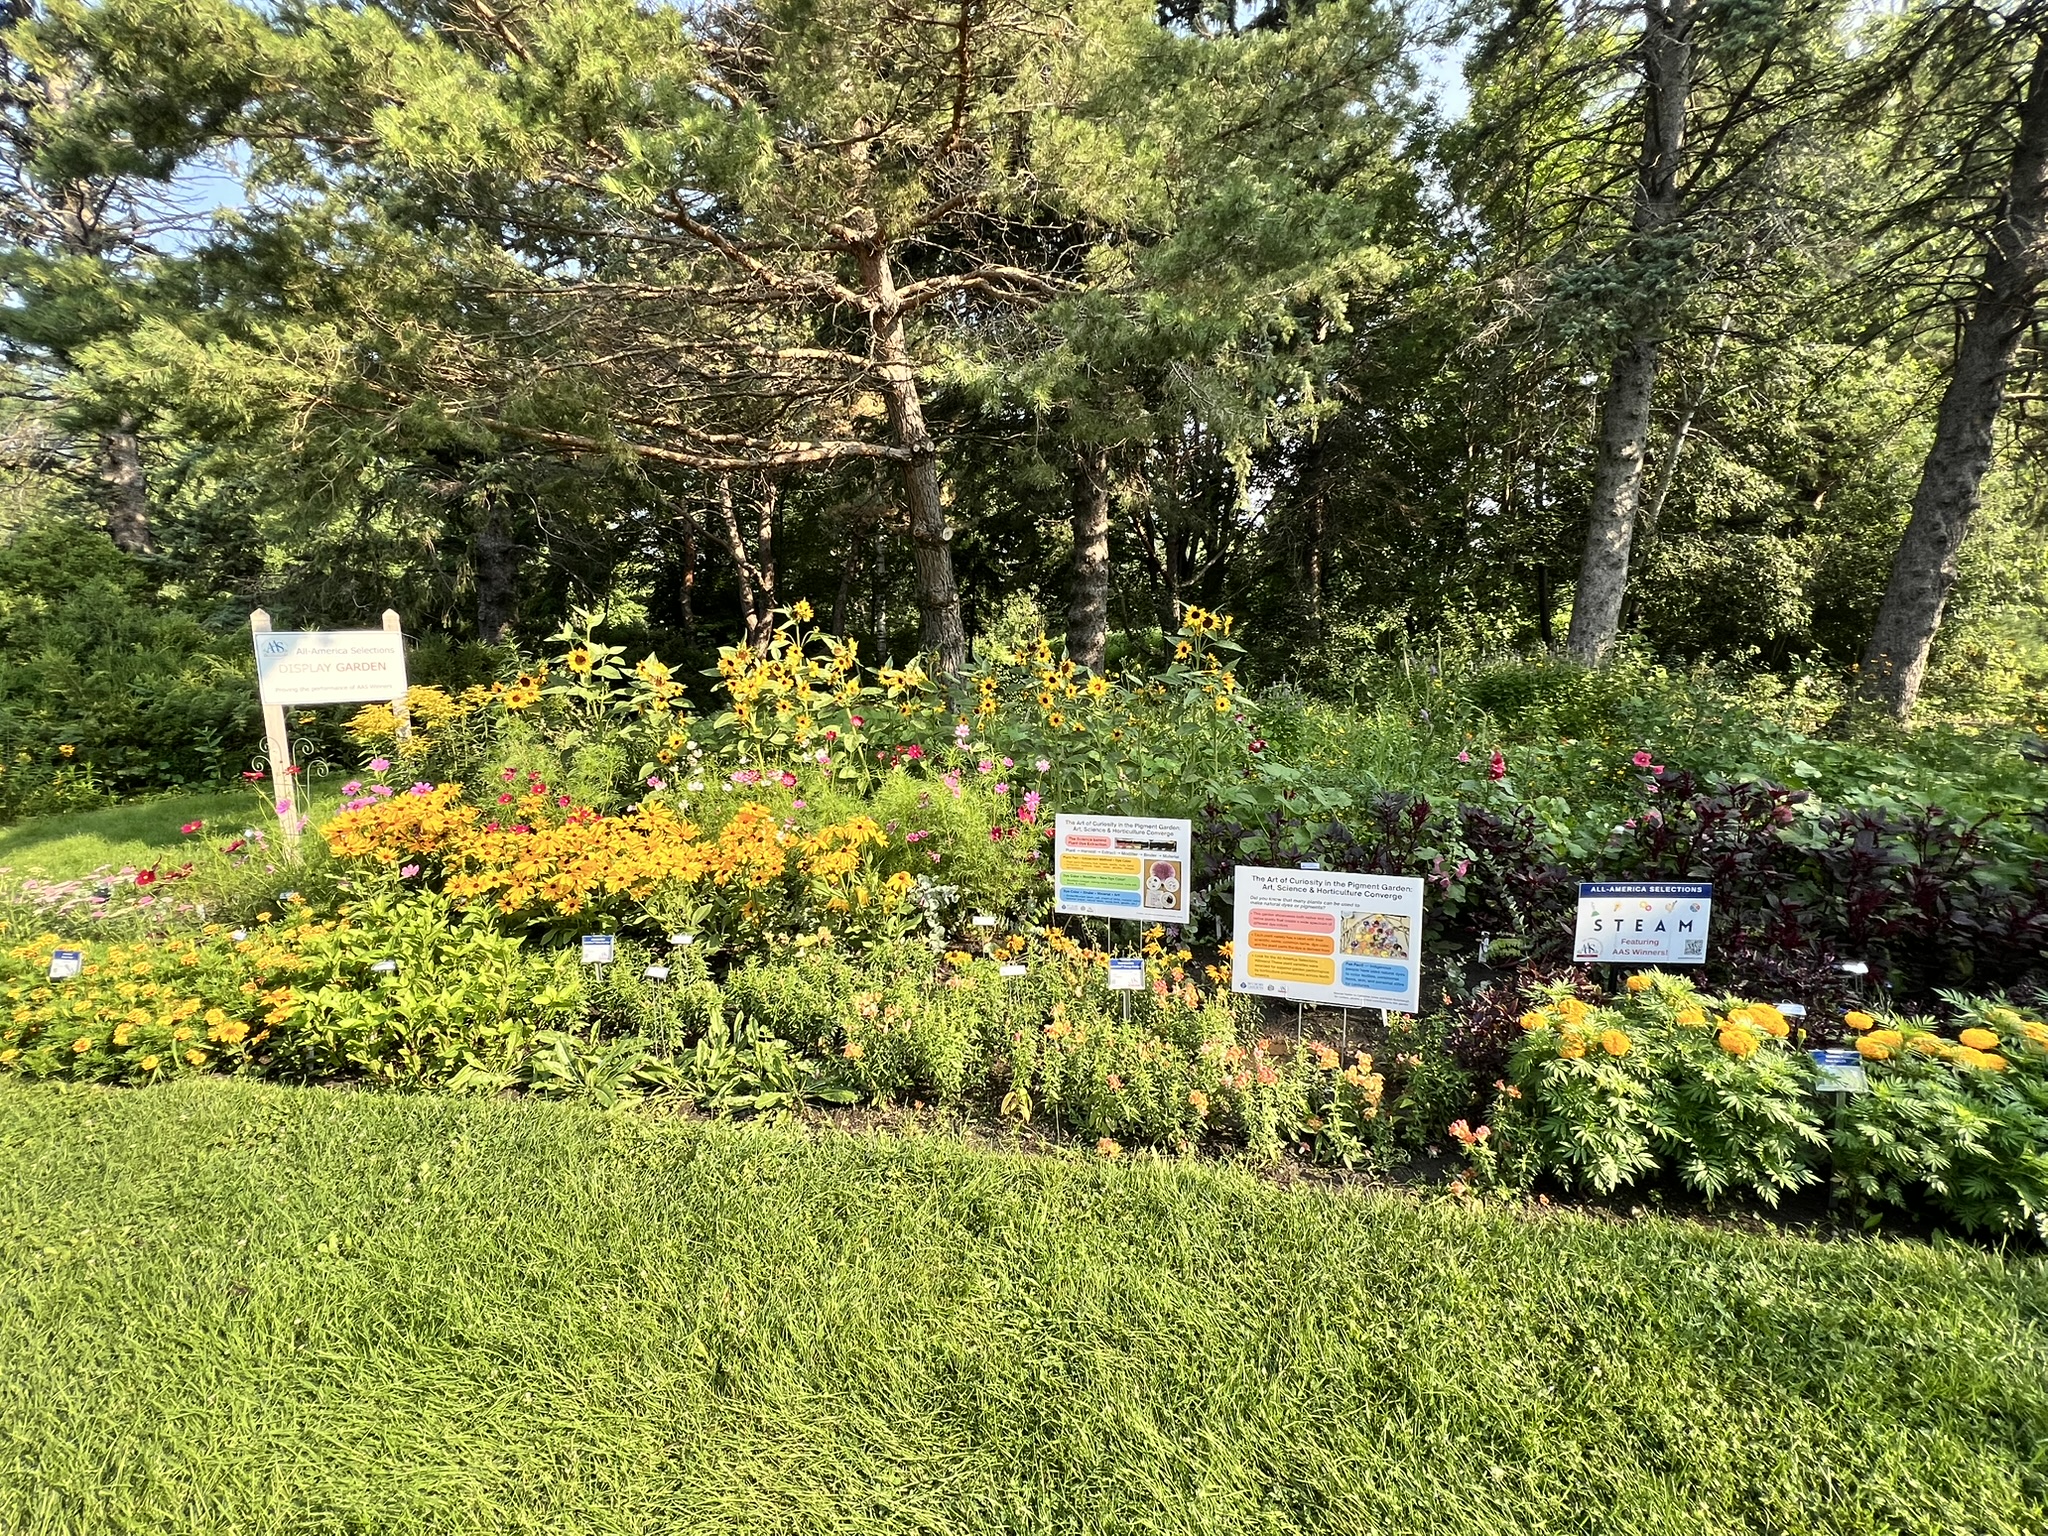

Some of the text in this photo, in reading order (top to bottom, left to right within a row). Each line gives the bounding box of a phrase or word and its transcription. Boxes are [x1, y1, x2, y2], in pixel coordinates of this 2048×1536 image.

[296, 647, 347, 655] All-America
[279, 662, 386, 673] DISPLAY GARDEN
[1290, 878, 1323, 887] Curiosity
[1348, 881, 1380, 890] Pigment
[1381, 884, 1412, 892] Garden:
[1277, 885, 1307, 893] Science
[1316, 888, 1362, 897] Horticulture
[1364, 891, 1402, 901] Converge
